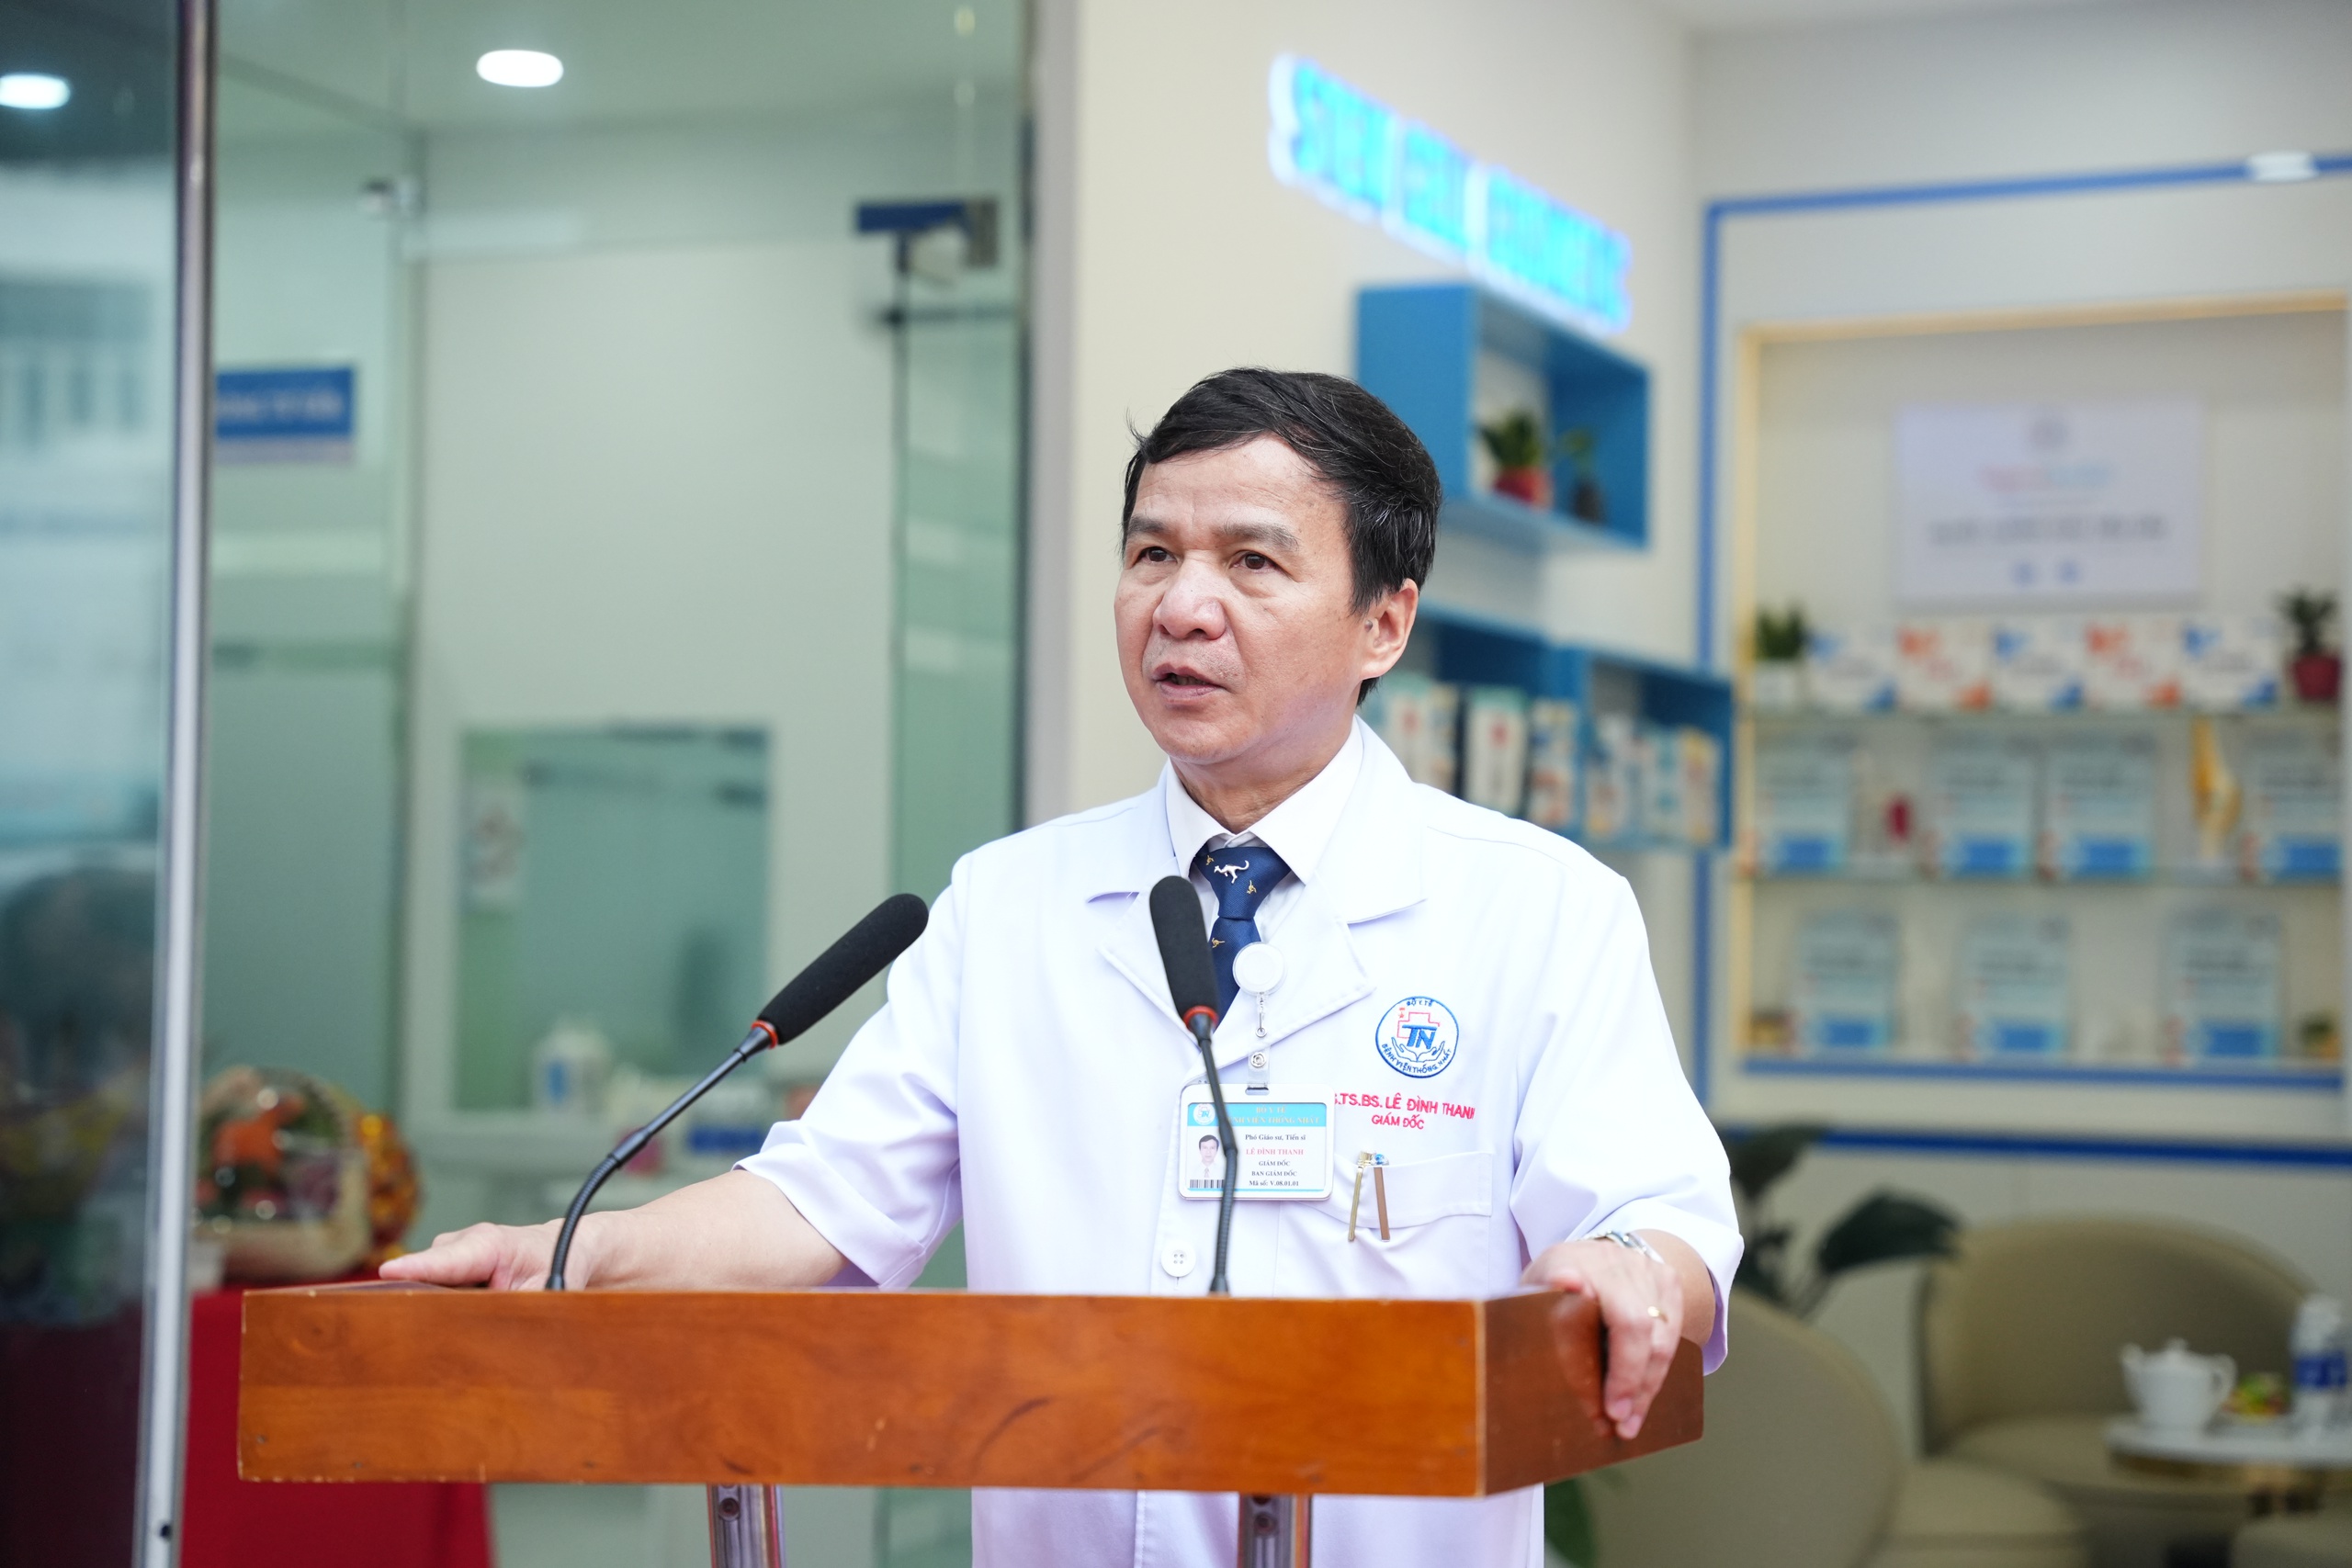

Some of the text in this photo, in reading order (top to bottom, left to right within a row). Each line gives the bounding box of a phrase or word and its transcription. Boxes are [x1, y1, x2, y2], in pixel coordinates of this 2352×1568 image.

[1402, 1024, 1438, 1050] TN
[1413, 1063, 1439, 1074] THỐNG
[1334, 1093, 1384, 1108] .TS.BS.
[1385, 1092, 1402, 1110] LÊ
[1407, 1095, 1439, 1114] ĐÌNH
[1371, 1111, 1425, 1130] GIÁM ĐỐC
[1246, 1147, 1255, 1156] LÊ
[1257, 1147, 1276, 1156] ĐÌNH
